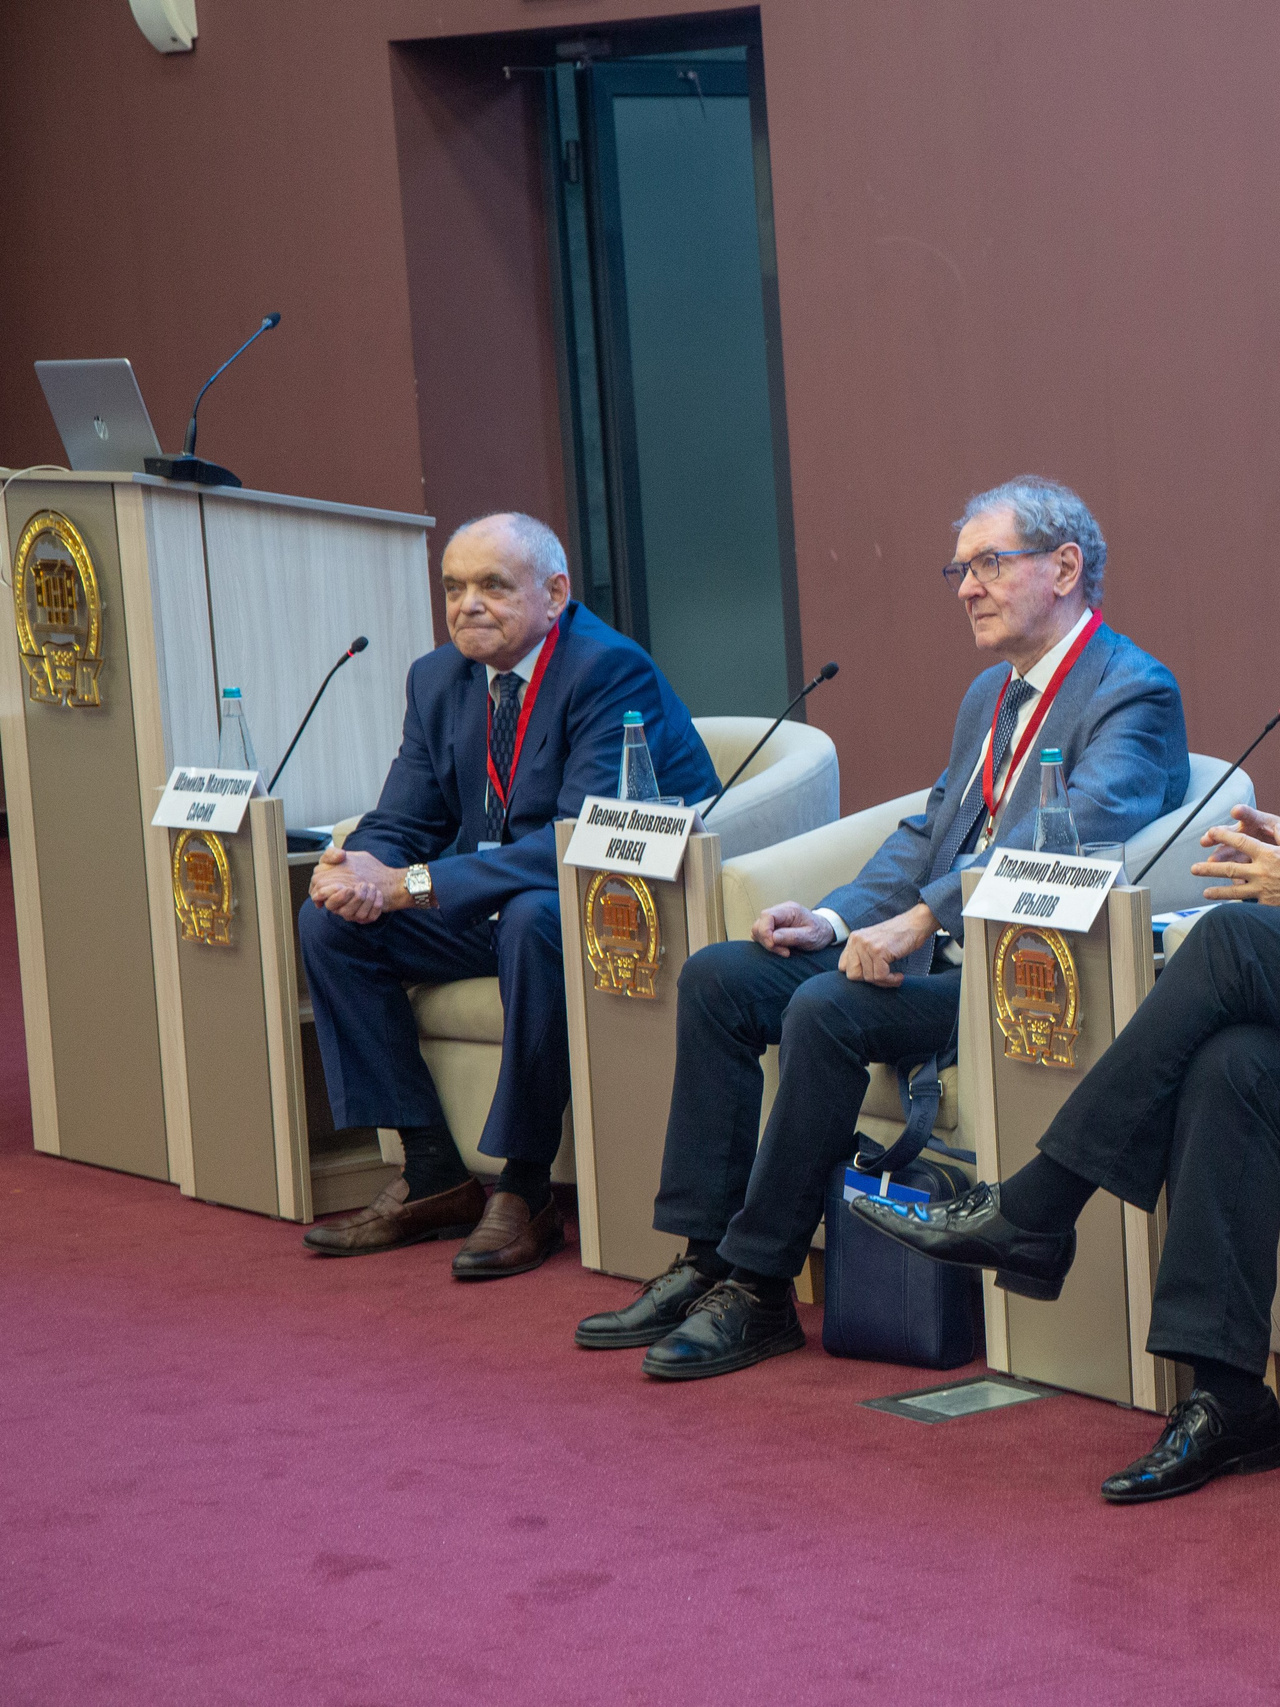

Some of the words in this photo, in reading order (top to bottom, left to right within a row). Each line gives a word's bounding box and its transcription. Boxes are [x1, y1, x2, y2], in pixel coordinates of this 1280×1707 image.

[173, 771, 206, 793] Шамиль
[203, 773, 252, 796] Махмутович
[186, 801, 217, 823] САФИН
[587, 804, 629, 832] Леонид
[626, 809, 687, 836] Яковлевич
[605, 837, 647, 866] КРАВЕЦ
[994, 854, 1052, 884] Владимир
[1046, 860, 1112, 890] Викторович
[1012, 891, 1060, 918] КРЫЛОВ
